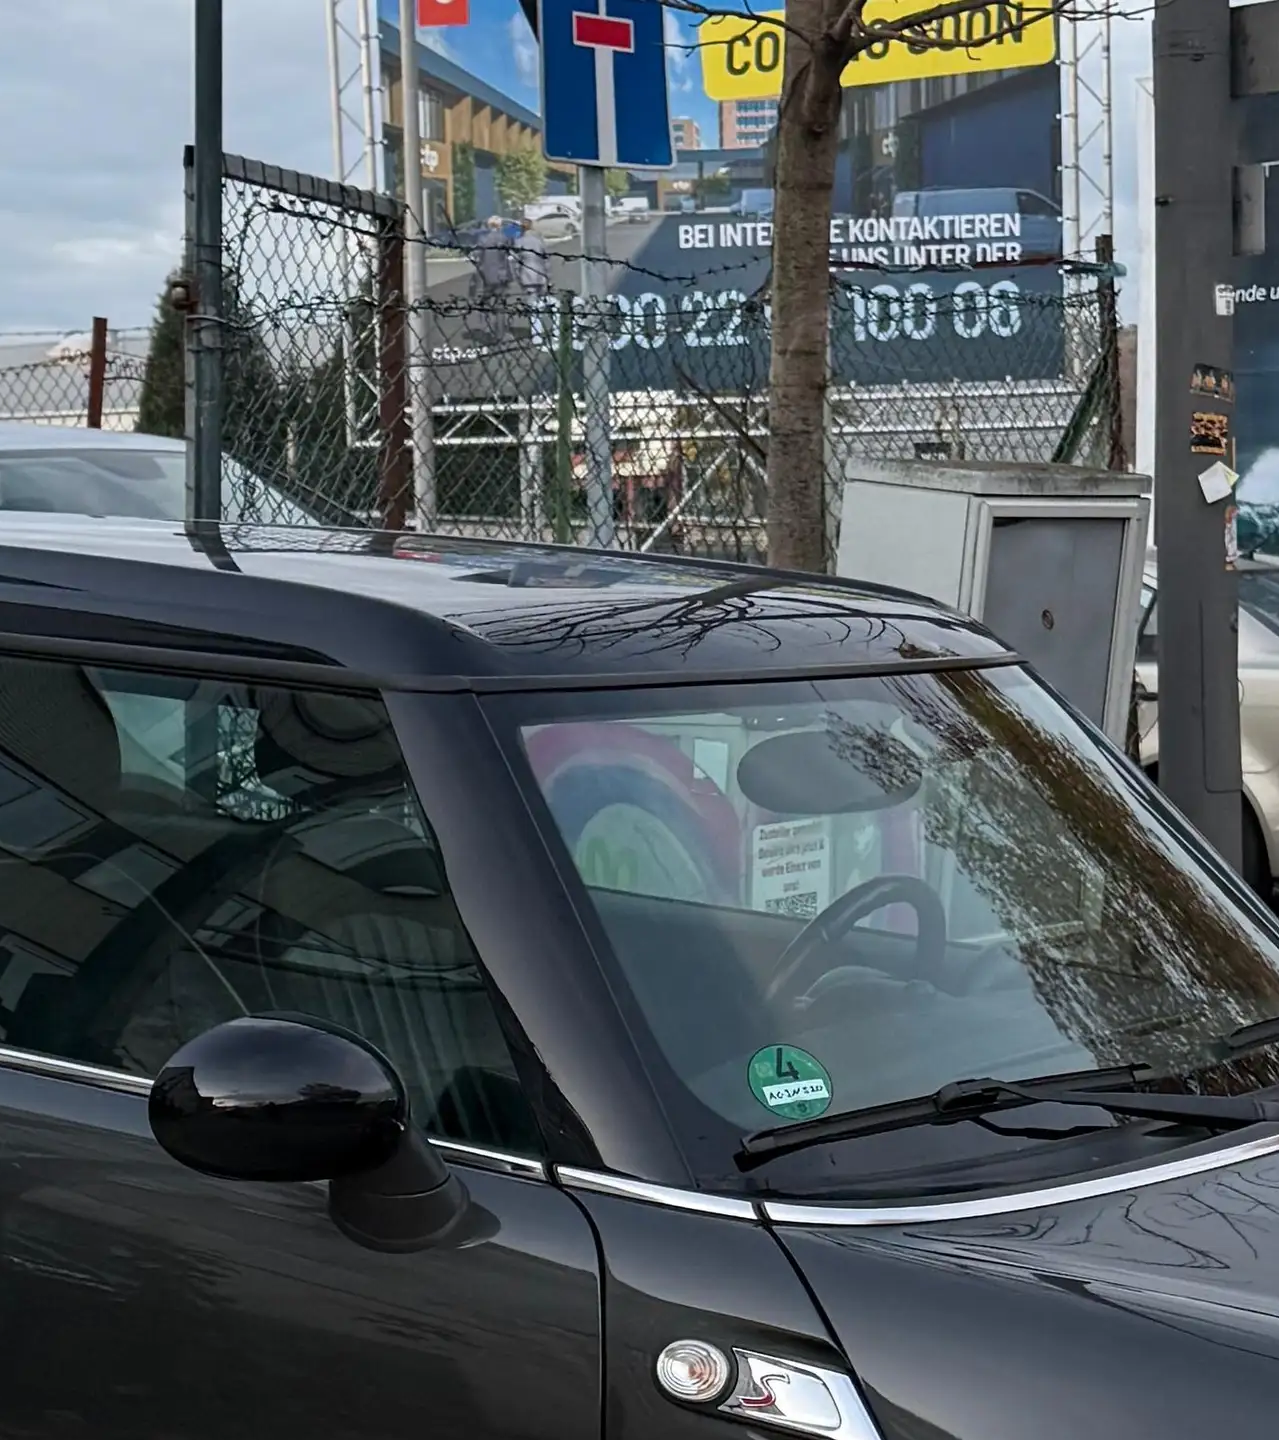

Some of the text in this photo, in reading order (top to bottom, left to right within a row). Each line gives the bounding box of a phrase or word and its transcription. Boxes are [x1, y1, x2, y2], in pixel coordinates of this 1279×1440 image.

[679, 224, 714, 249] BEI
[849, 213, 1021, 243] KONTAKTIEREN
[894, 244, 971, 266] UNTER
[776, 1047, 800, 1080] 4
